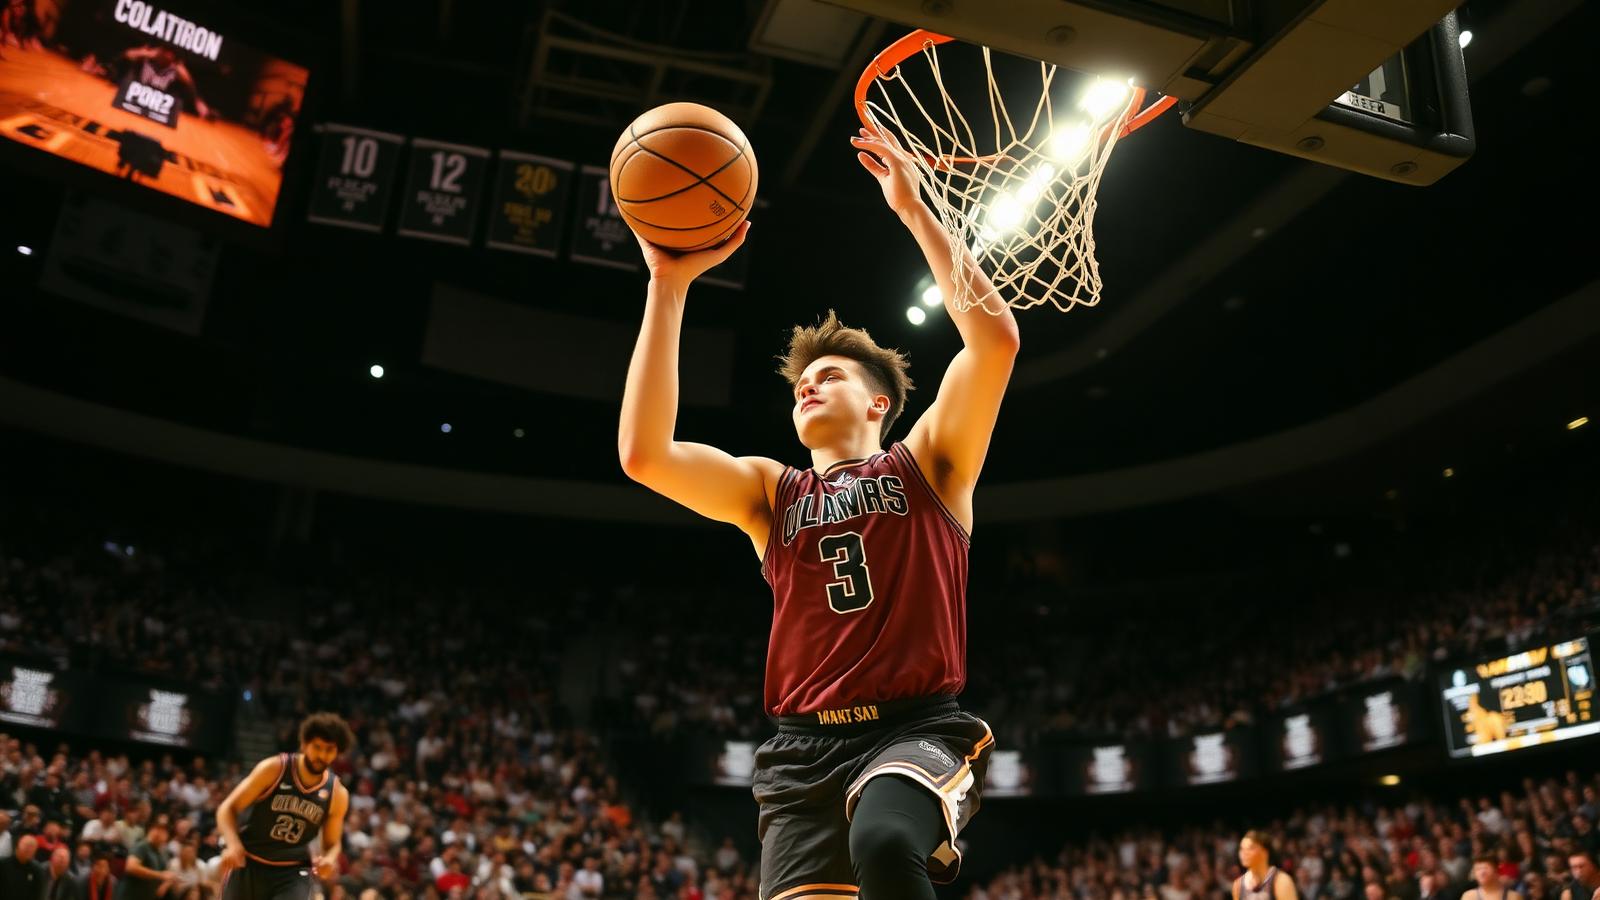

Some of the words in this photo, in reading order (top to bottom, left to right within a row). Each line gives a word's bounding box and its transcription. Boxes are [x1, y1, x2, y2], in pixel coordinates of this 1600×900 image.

[341, 136, 379, 179] 10
[429, 151, 468, 193] 12
[818, 531, 874, 614] 3
